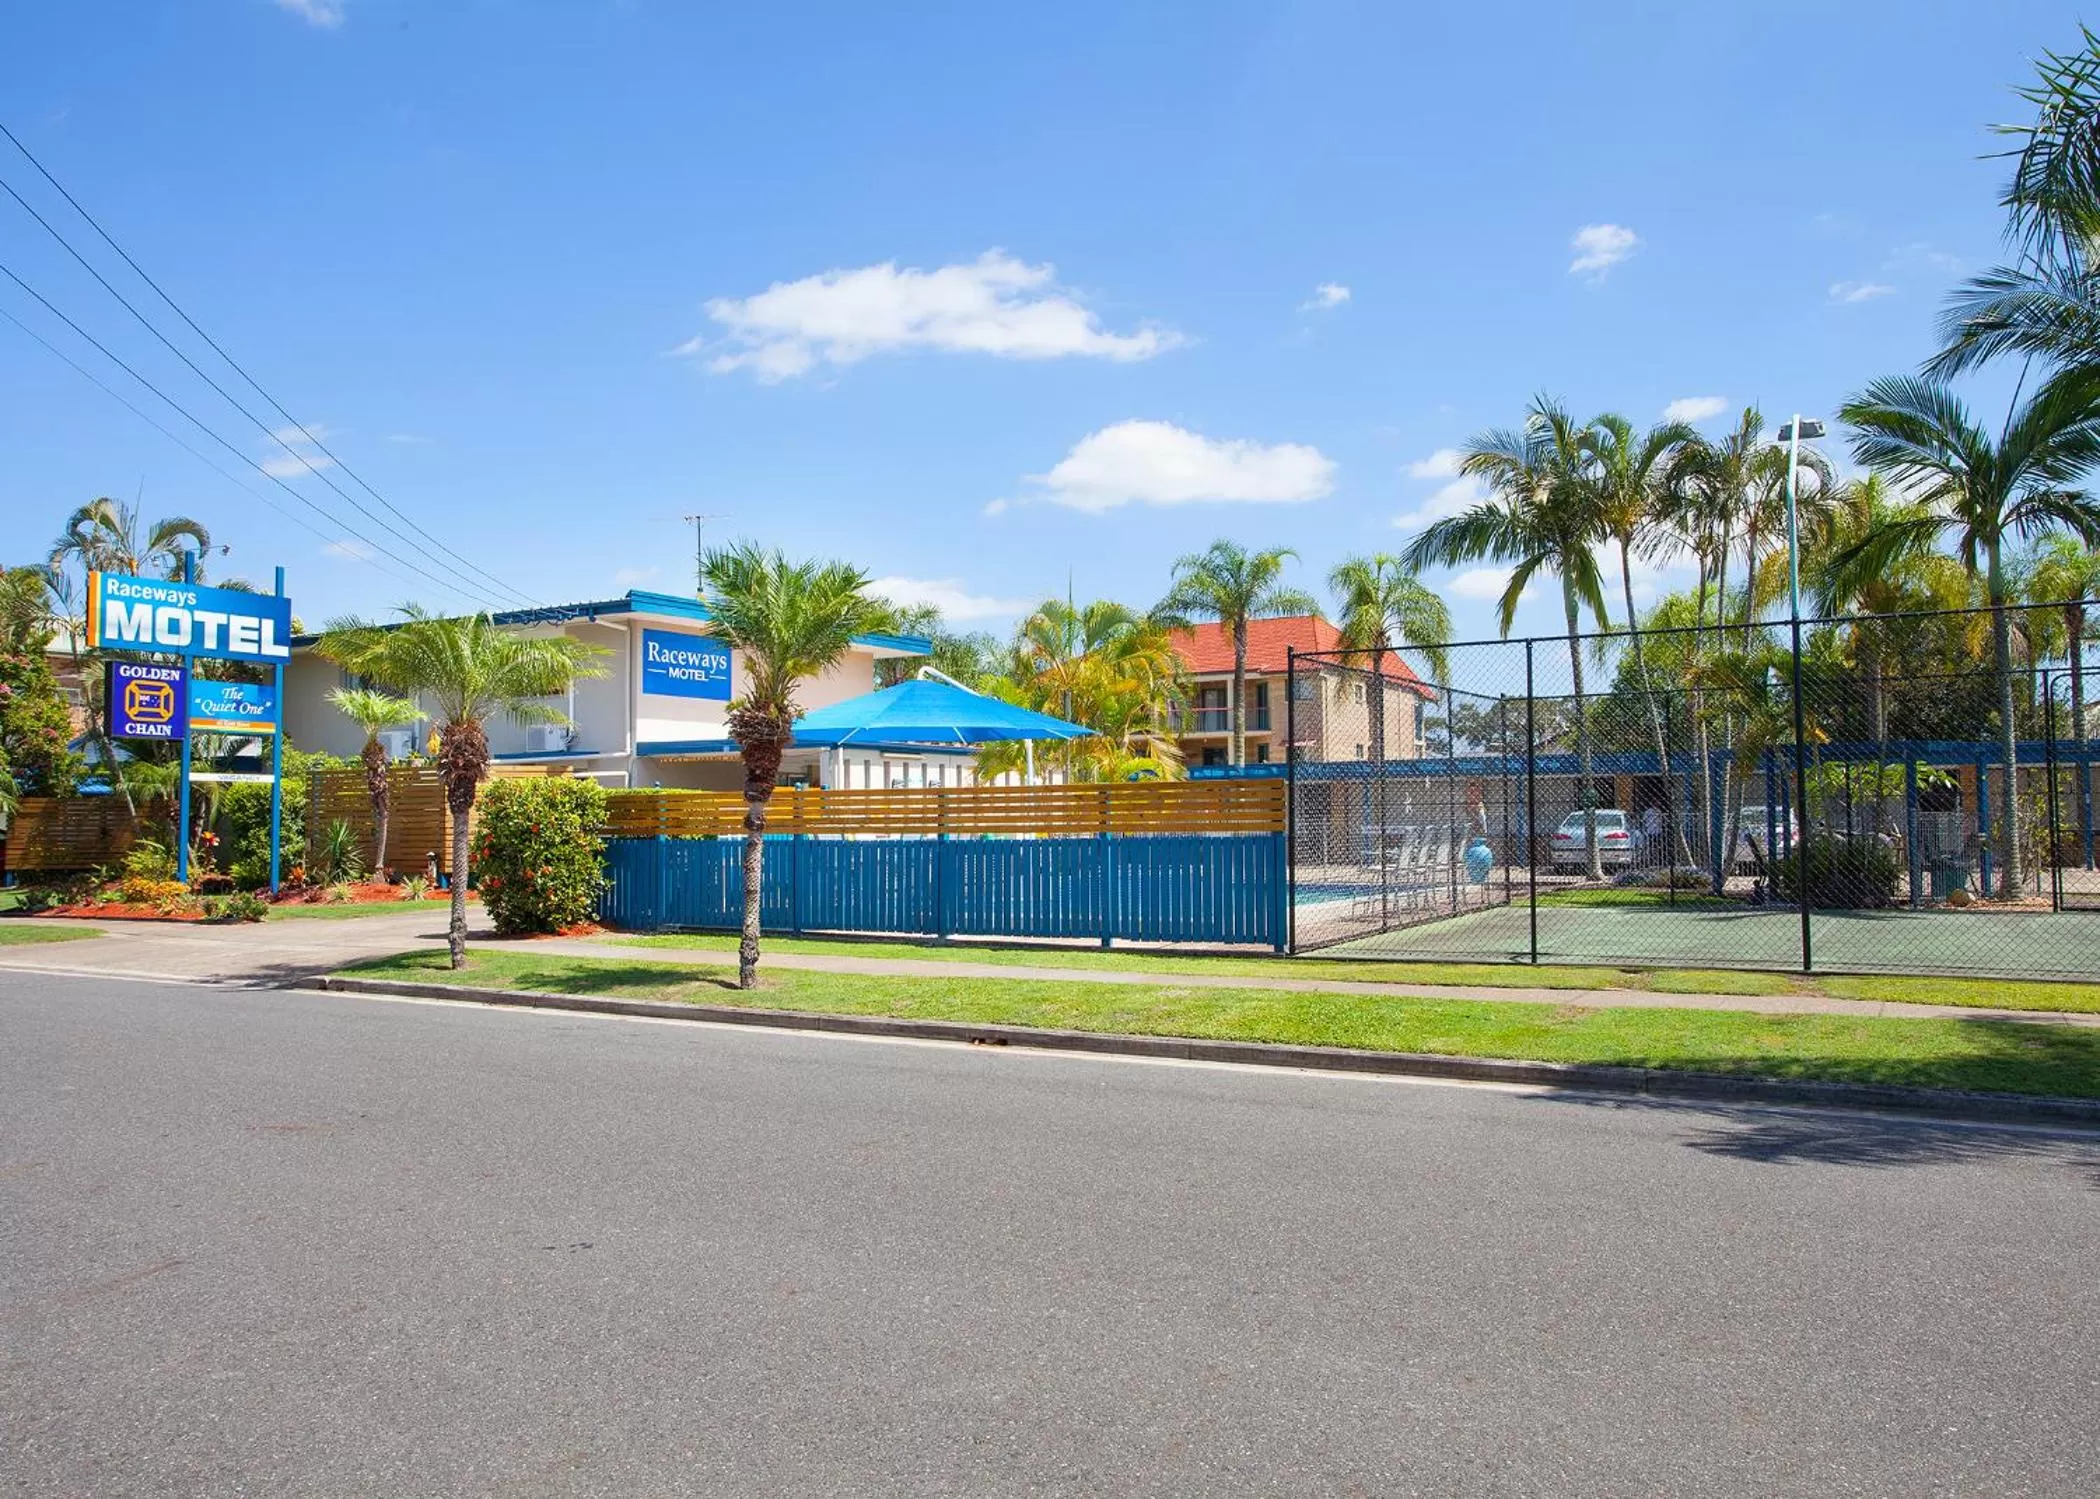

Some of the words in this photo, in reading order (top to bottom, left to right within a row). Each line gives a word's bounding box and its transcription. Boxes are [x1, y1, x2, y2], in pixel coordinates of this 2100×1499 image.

[107, 578, 197, 606] Raceways
[105, 600, 289, 657] MOTEL
[647, 641, 728, 674] Raceways
[120, 665, 180, 681] GOLDEN
[668, 666, 709, 682] MOTEL
[222, 687, 244, 700] The
[125, 722, 172, 736] CHAIN
